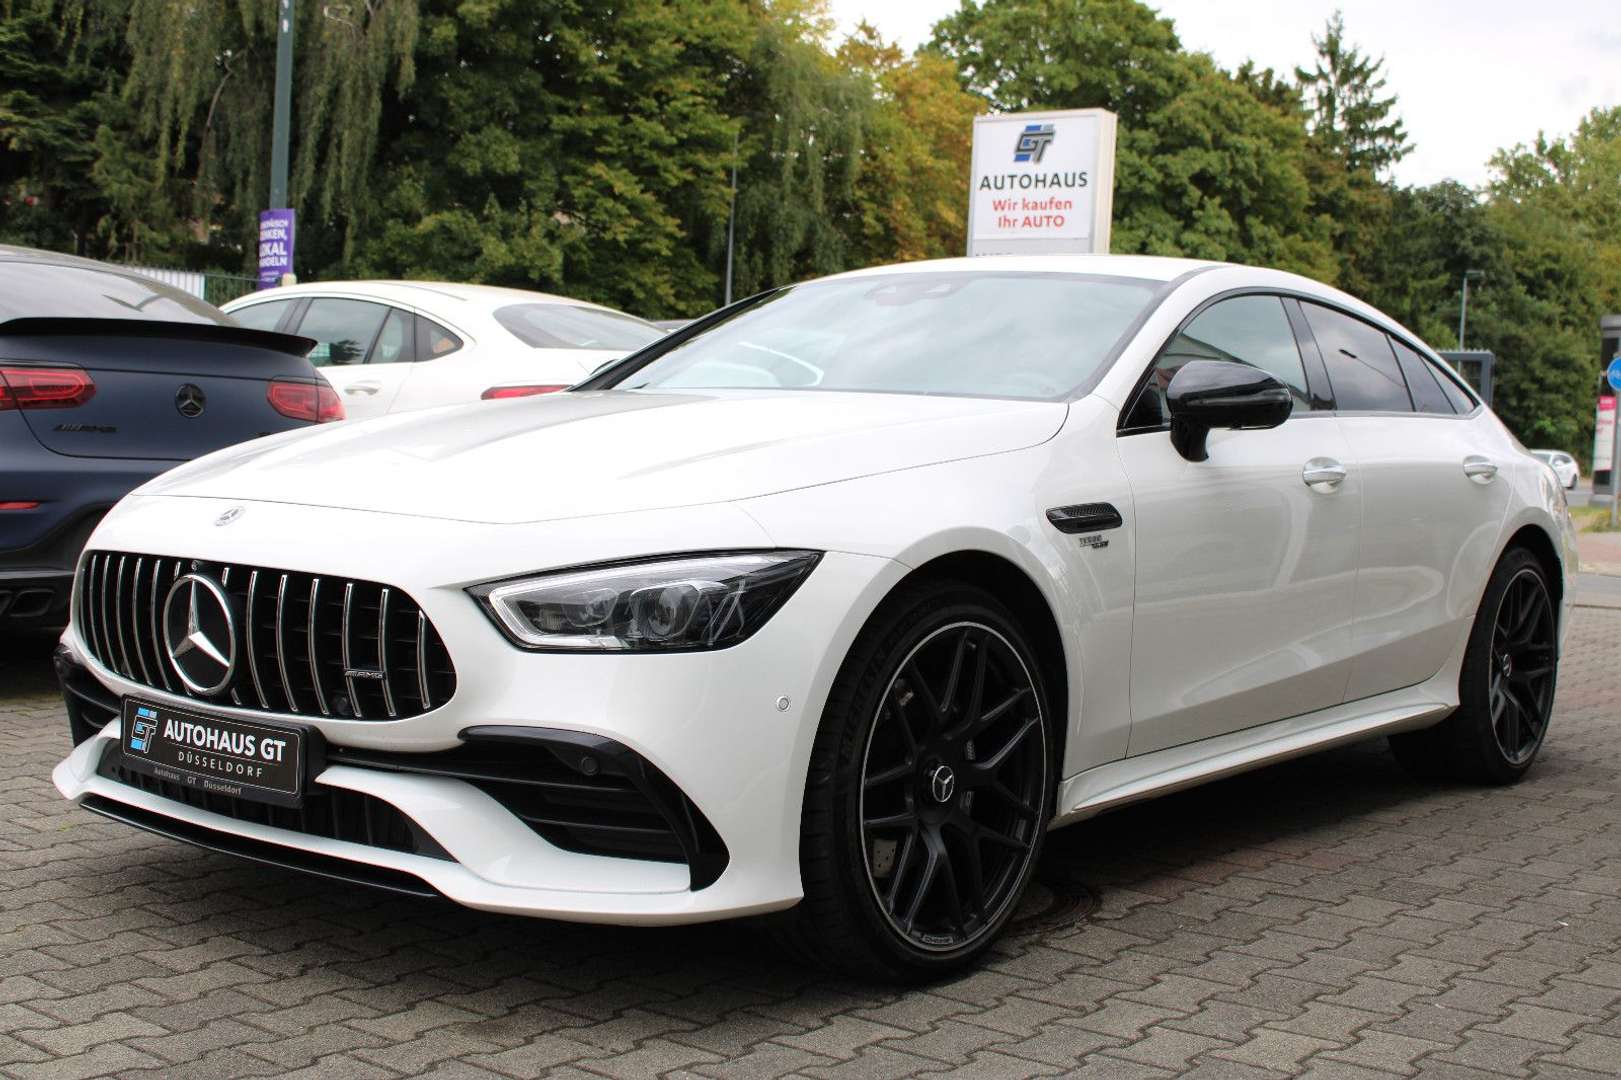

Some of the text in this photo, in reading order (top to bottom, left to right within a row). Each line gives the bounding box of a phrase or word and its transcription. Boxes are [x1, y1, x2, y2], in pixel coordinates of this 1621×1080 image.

[979, 172, 1088, 191] AUTOHAUS
[992, 197, 1073, 212] Wir kaufen
[998, 215, 1065, 229] Ihr AUTO
[163, 718, 286, 762] AUTOHAUS GT
[178, 751, 264, 778] DÜSSELDORF
[187, 775, 197, 785] GT
